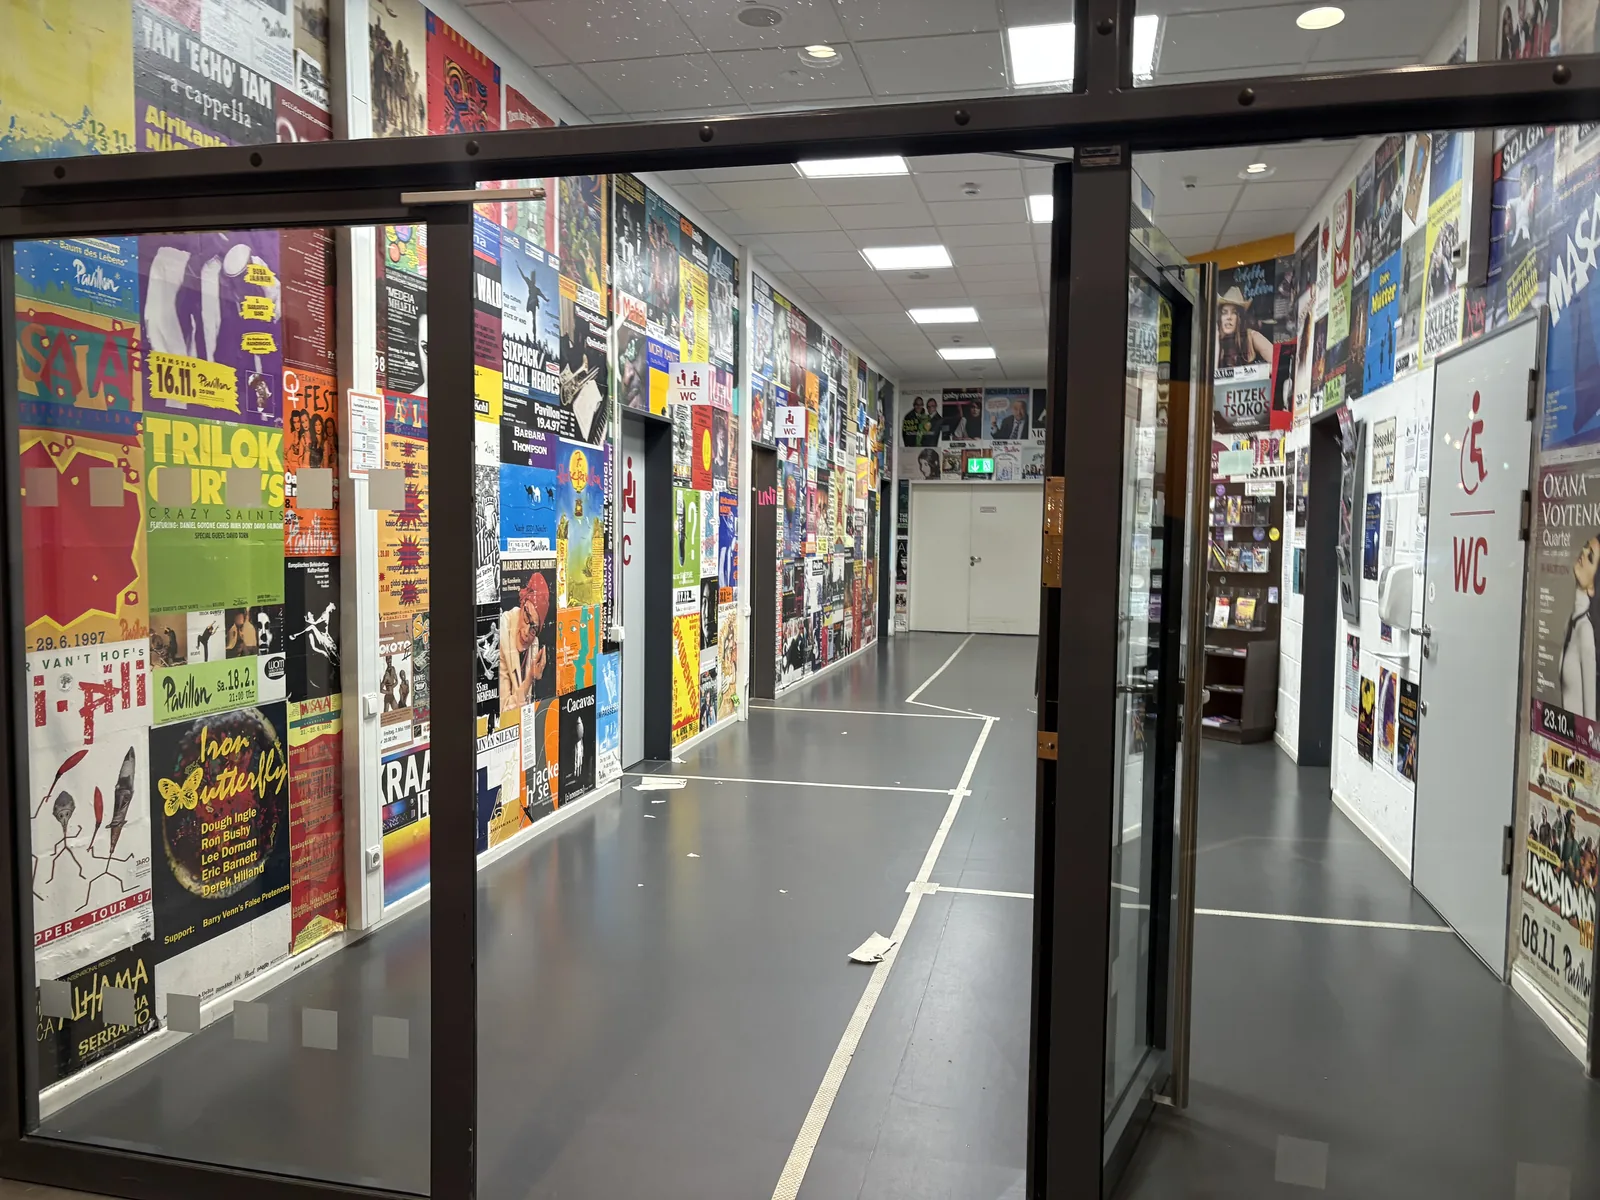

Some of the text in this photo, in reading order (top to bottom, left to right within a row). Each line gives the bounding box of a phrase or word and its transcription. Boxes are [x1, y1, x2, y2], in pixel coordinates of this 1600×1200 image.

[142, 15, 181, 63] TAM
[240, 66, 273, 110] TAM
[169, 77, 251, 129] a cappella
[83, 247, 97, 259] des
[154, 356, 197, 369] SAMSTAG
[156, 363, 197, 398] 16.11.
[503, 360, 560, 396] LOCAL HEROES
[680, 391, 697, 402] WC
[1226, 387, 1267, 404] FITZEK
[534, 402, 560, 420] Pavillon
[1223, 401, 1270, 418] TSOKOS
[513, 425, 546, 442] BARBARA
[536, 416, 560, 432] 19.4.97
[783, 428, 797, 436] WC
[146, 416, 284, 471] TRILOK
[511, 440, 548, 456] THOMPSON
[1543, 472, 1588, 499] OXANA
[149, 506, 284, 521] CRAZY SAINTS
[1542, 529, 1571, 548] Quartet
[1453, 536, 1488, 595] WC
[162, 673, 213, 714] Pavillon
[566, 693, 596, 714] Cacavas
[495, 725, 519, 744] SILENCE
[1543, 708, 1570, 738] 23.10.
[200, 725, 250, 763] Iron
[532, 759, 559, 793] jacke
[201, 808, 257, 834] Dough Ingle
[201, 825, 251, 850] Ron Bushy
[201, 837, 258, 866] Lee Dorman
[201, 851, 258, 881] Eric Barnett
[202, 863, 265, 897] Derek Hilland
[91, 900, 127, 921] TOUR
[164, 926, 196, 945] Support:
[202, 910, 222, 928] Barry
[244, 893, 261, 910] False
[261, 883, 290, 905] Pretences
[1521, 911, 1560, 976] 08.11.
